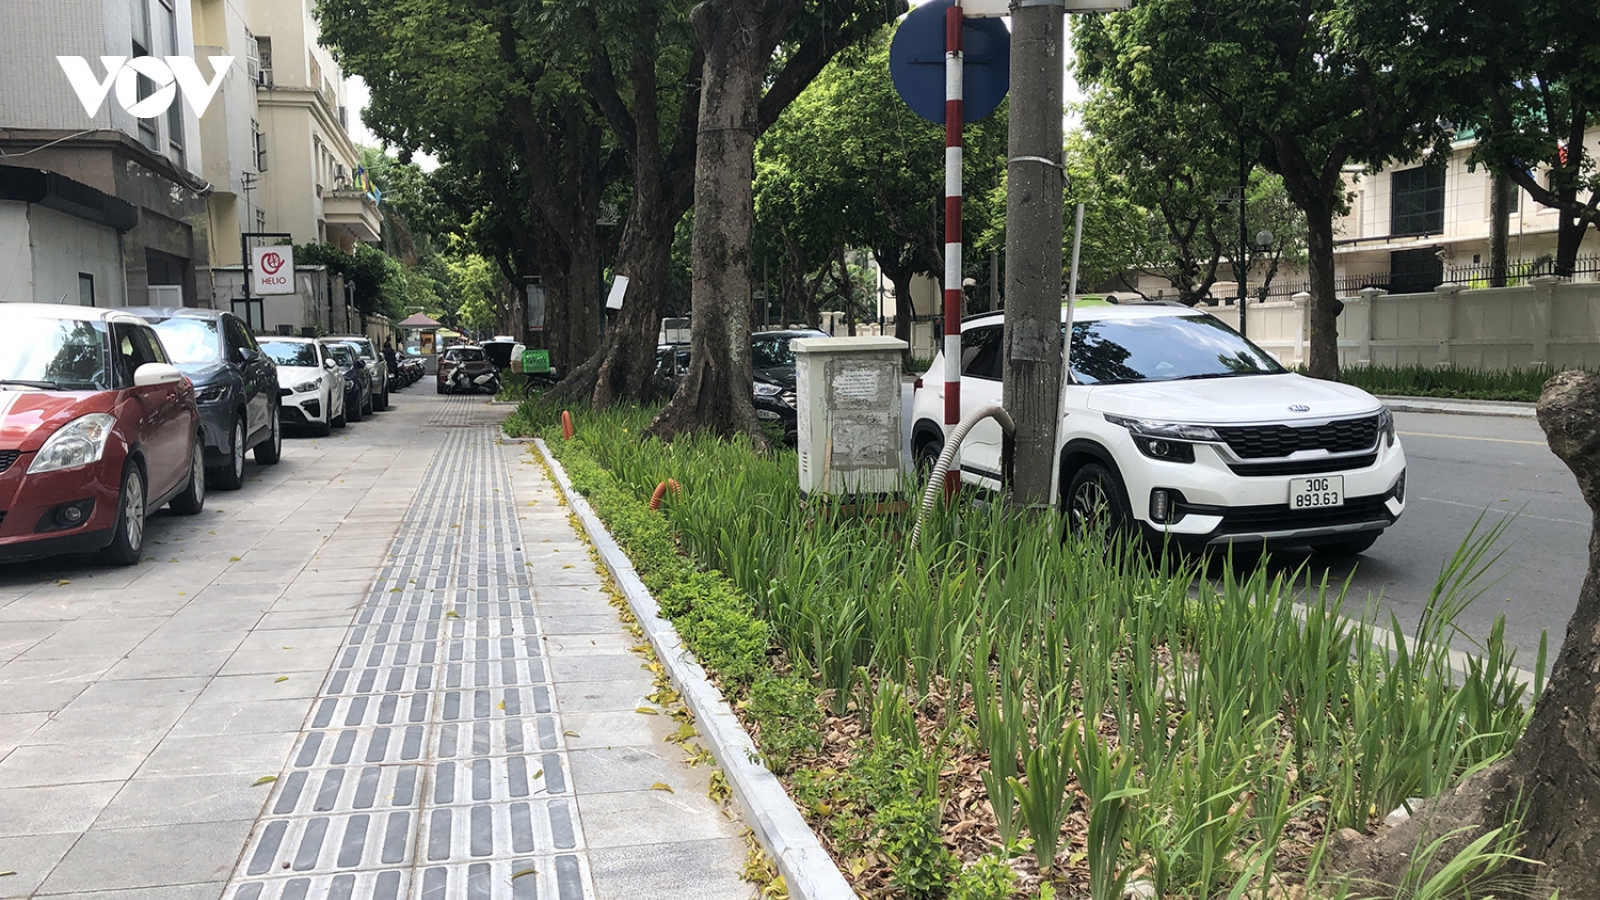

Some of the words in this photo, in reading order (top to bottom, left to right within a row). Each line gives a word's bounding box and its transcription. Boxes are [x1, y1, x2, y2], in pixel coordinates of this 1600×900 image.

[261, 276, 287, 285] HELIO
[1306, 478, 1329, 492] 30G
[1296, 492, 1338, 507] 893.63
